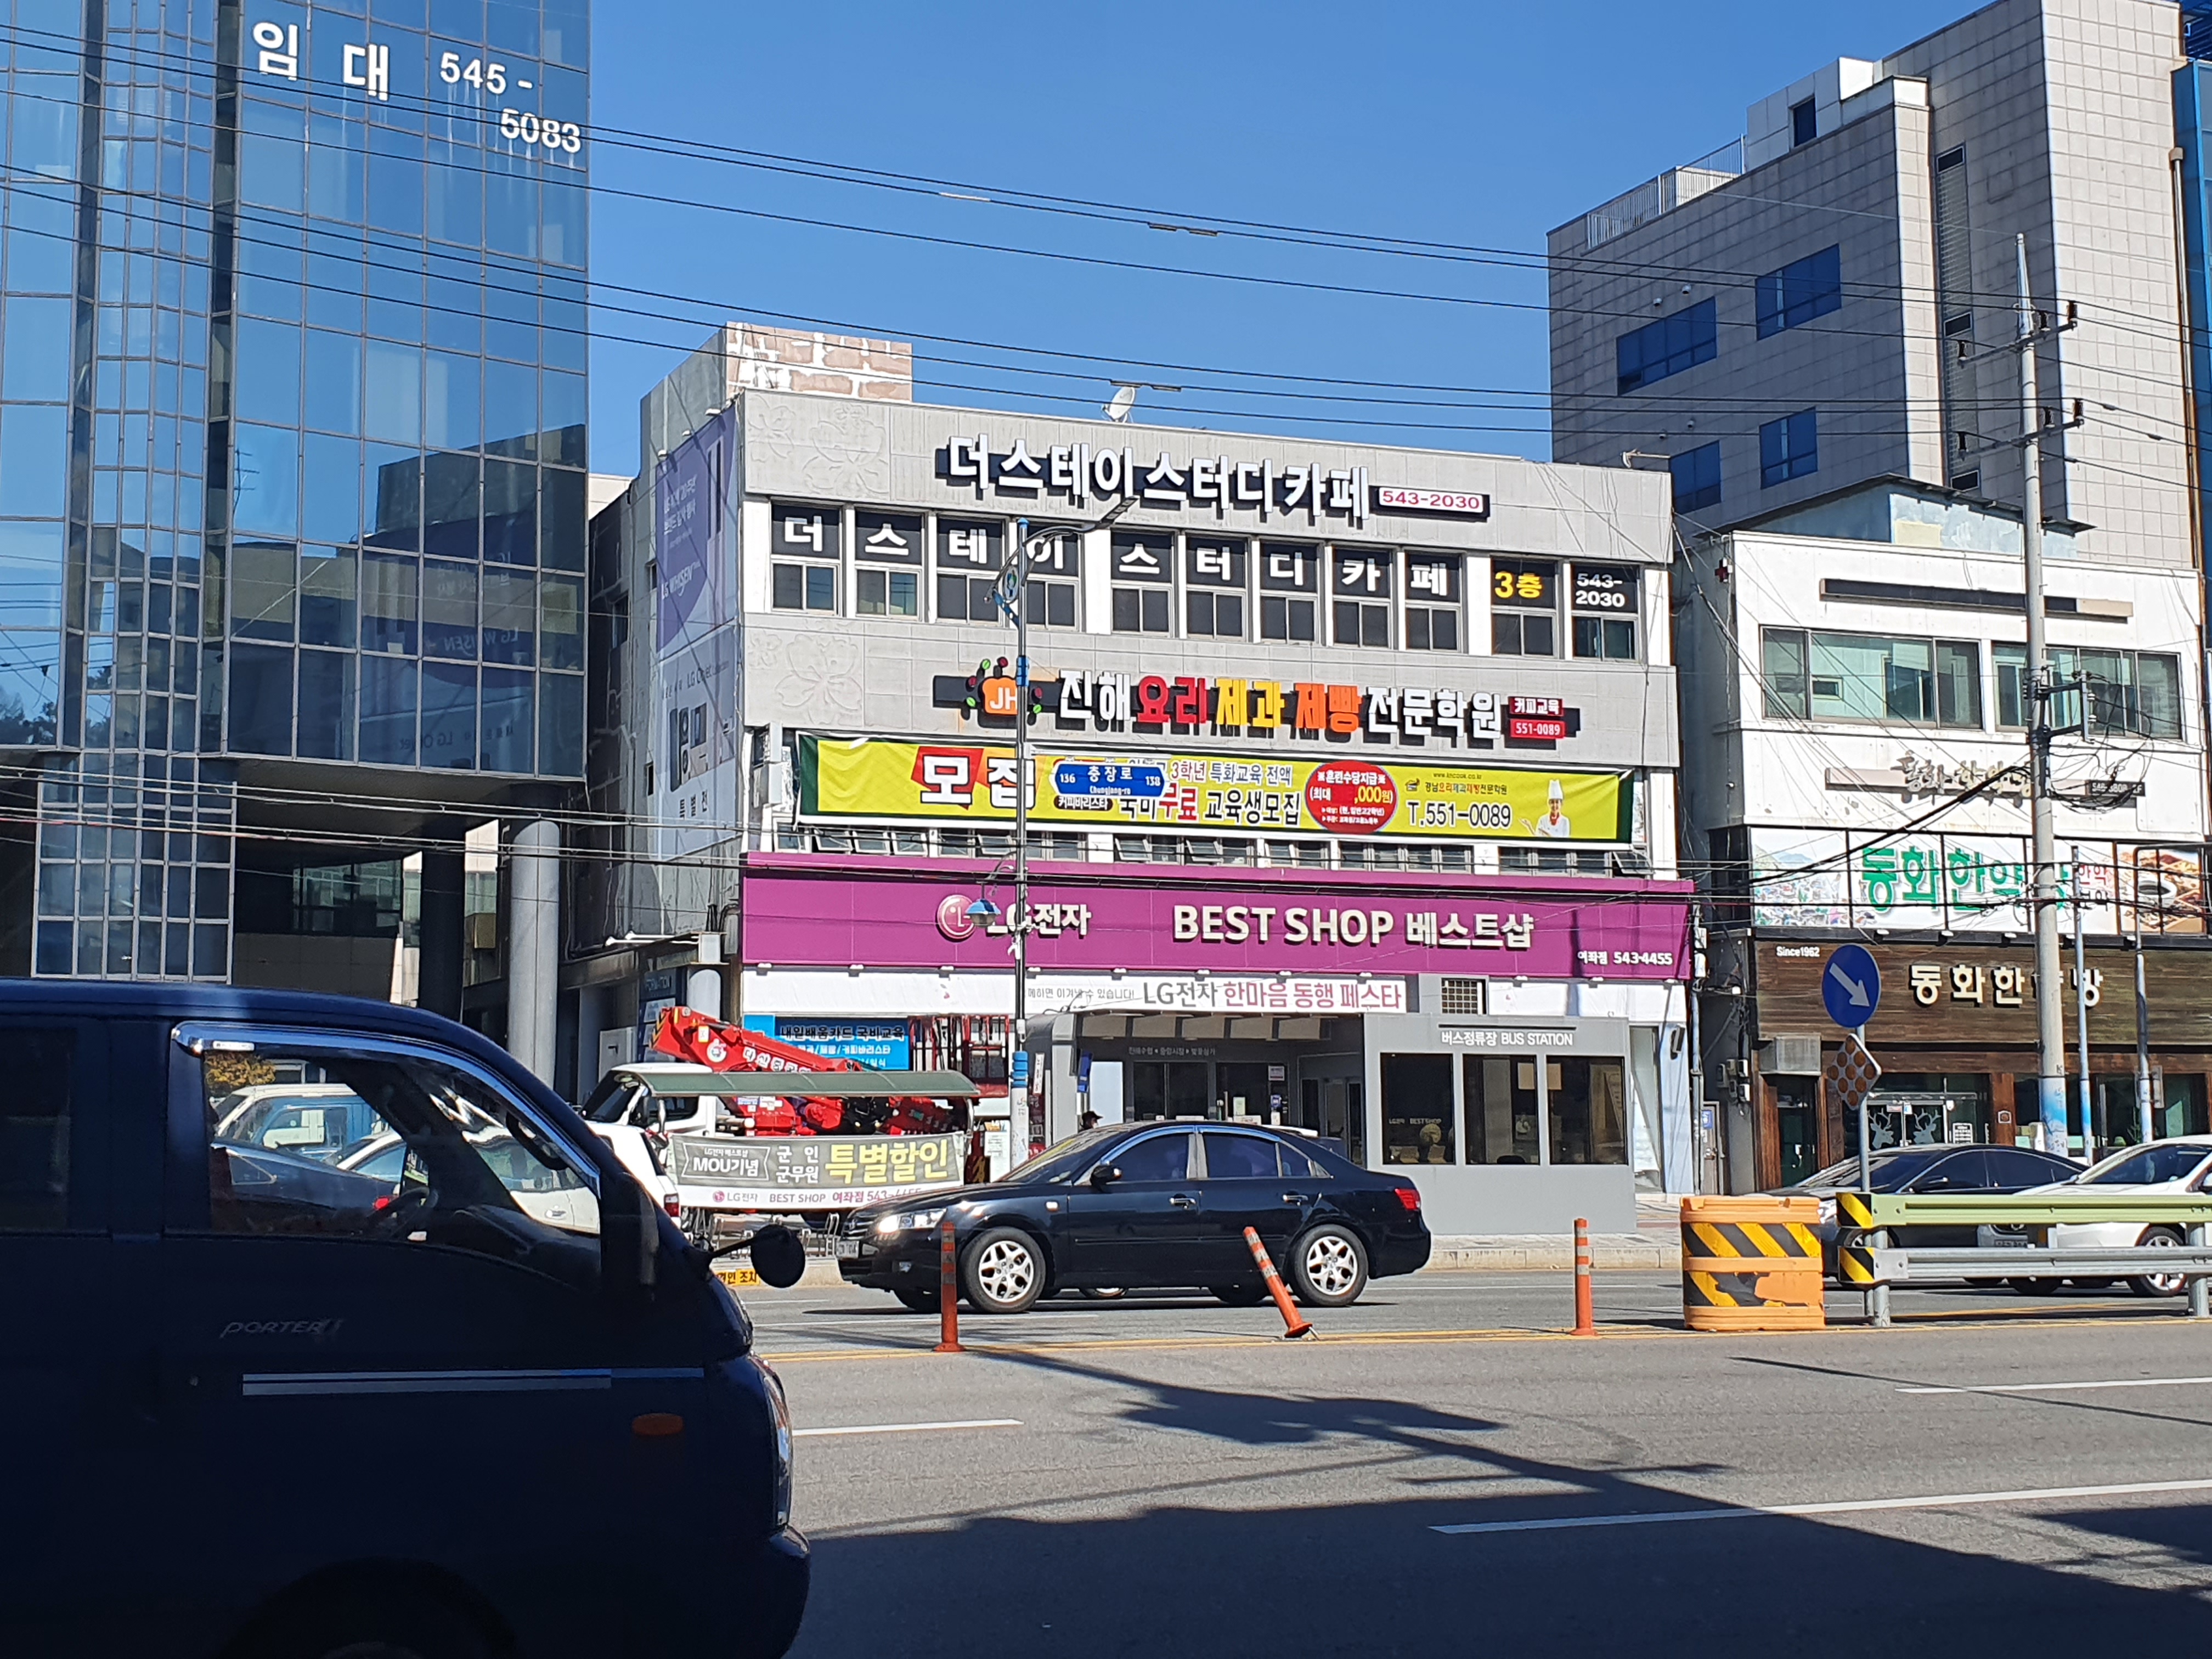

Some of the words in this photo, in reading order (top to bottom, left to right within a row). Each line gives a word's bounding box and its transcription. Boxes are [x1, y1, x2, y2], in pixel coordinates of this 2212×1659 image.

[500, 108, 580, 154] 5083
[1381, 488, 1481, 511] 543-2030
[1494, 571, 1543, 599] 3층
[1575, 590, 1626, 608] 2030
[1514, 697, 1560, 715] 커피교육
[1515, 721, 1561, 736] 551-0089
[1059, 773, 1076, 783] 136
[1087, 765, 1133, 783] 충장로
[1145, 775, 1161, 787] 138
[1171, 760, 1206, 782] 3학년
[1210, 762, 1262, 784] 특화교육
[1266, 765, 1292, 786] 전액
[1058, 795, 1109, 811] 커피바리스타
[1205, 789, 1300, 826] 교육생모집
[1407, 801, 1511, 828] T.551-0089
[1173, 905, 1276, 942] BEST
[1284, 907, 1394, 945] SHOP
[1404, 912, 1534, 949] 베스트샵
[1613, 951, 1673, 966] 543-4455
[1143, 981, 1218, 1008] LG전자
[1223, 981, 1288, 1008] 한마음
[1293, 982, 1335, 1008] 동행
[1340, 984, 1402, 1009] 페스타
[1911, 964, 2104, 1007] 동화한방
[780, 1025, 854, 1041] 내일배움카드
[856, 1025, 905, 1041] 국비교육
[1441, 1031, 1498, 1047] 버스정류장
[1500, 1032, 1525, 1046] BUS
[1527, 1033, 1573, 1046] STATION
[693, 1156, 759, 1177] MOU기념
[825, 1139, 949, 1184] 특별할인
[776, 1165, 819, 1184] 군무원
[769, 1193, 795, 1203] BEST
[798, 1193, 826, 1203] SHOP
[219, 1321, 325, 1339] PORTER
